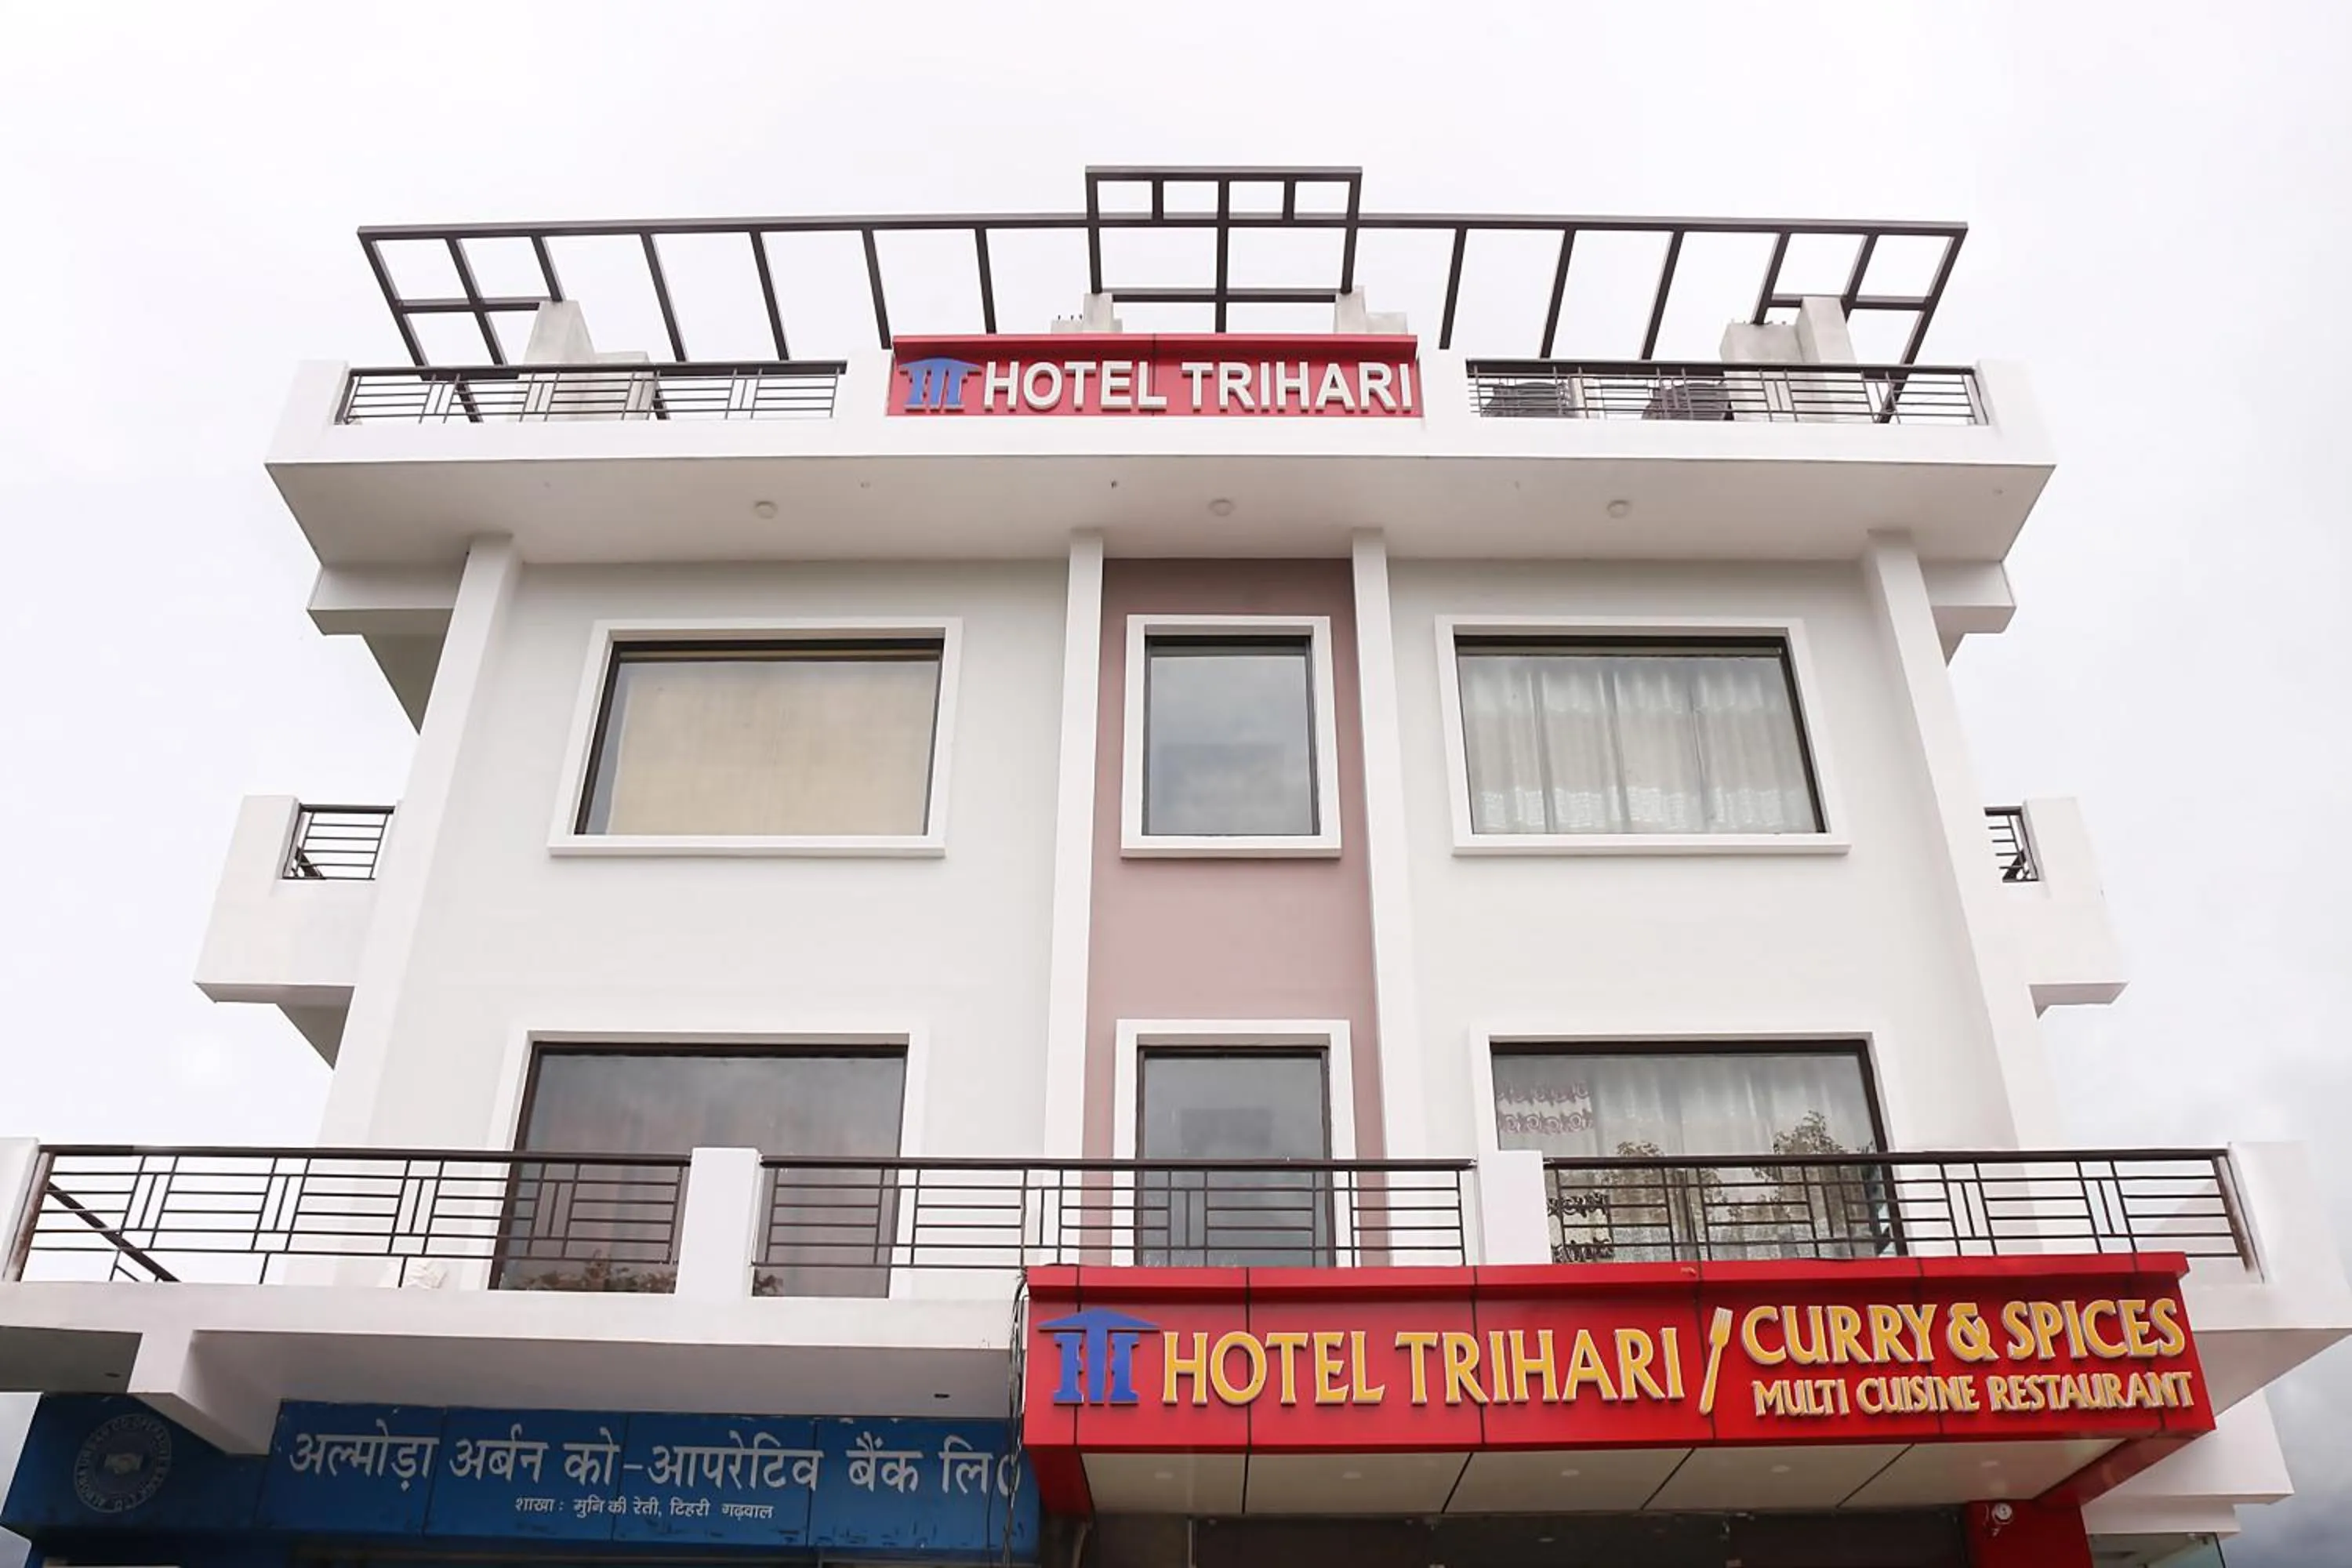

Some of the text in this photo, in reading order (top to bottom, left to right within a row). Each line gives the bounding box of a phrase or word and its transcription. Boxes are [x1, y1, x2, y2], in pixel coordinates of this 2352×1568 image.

[982, 360, 1414, 412] HOTEL TRIHARI
[1740, 1298, 2187, 1366] CURRY & SPICES
[1161, 1327, 1686, 1405] HOTEL TRIHARI
[1752, 1370, 2195, 1417] MULTI CUISINE RESTAURANT
[289, 1419, 440, 1493] अल्मोड़ा
[449, 1424, 549, 1484] अर्बन
[846, 1432, 923, 1493] बैंक
[573, 1494, 605, 1519] मुनि
[608, 1495, 626, 1515] की
[670, 1497, 710, 1518] टिहरी
